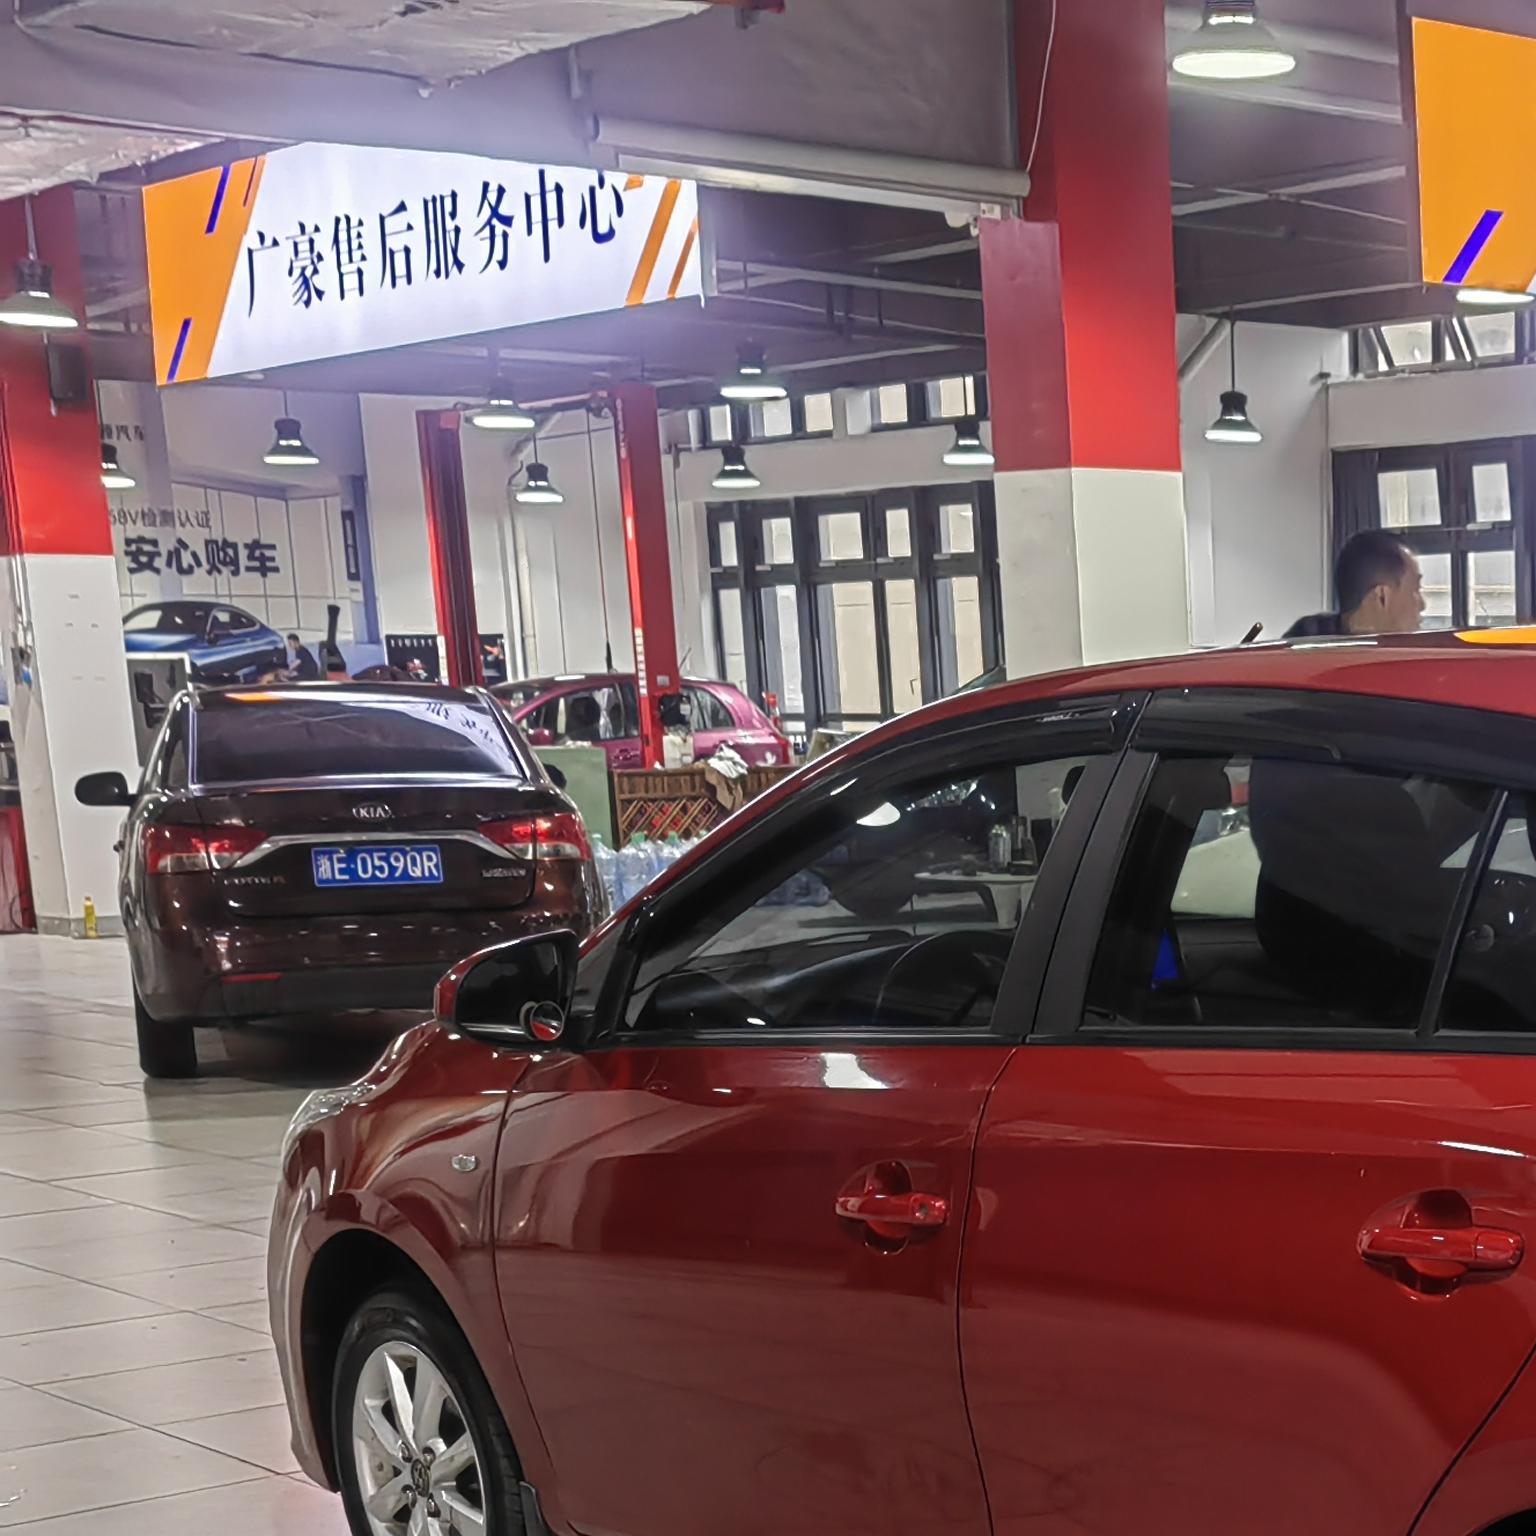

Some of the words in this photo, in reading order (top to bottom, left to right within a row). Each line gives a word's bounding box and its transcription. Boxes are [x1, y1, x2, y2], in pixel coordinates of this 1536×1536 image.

[244, 167, 626, 319] 广豪售后服务中心
[124, 535, 281, 578] 安心购车
[358, 805, 385, 819] KIA
